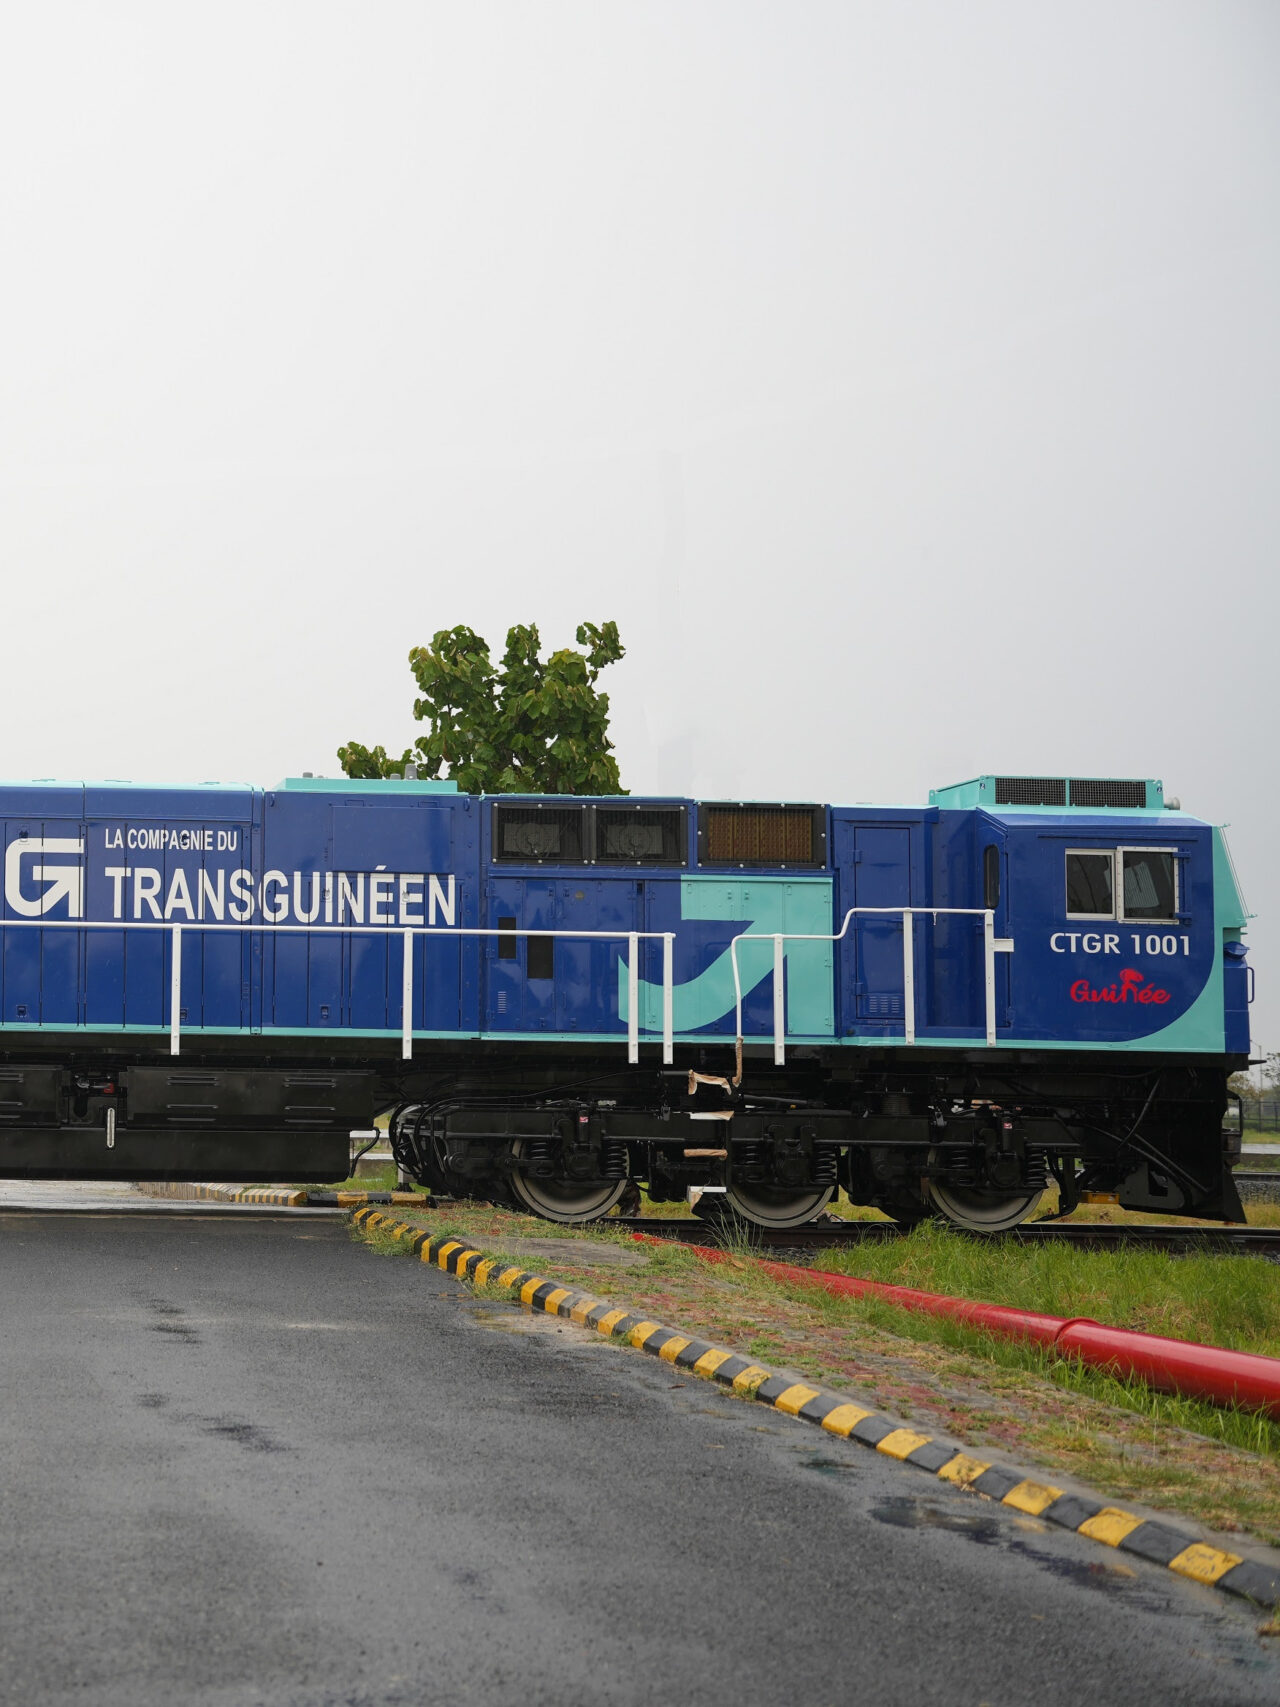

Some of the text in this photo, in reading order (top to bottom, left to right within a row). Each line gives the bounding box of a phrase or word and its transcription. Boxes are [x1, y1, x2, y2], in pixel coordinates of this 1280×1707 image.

[105, 828, 238, 851] LA COMPAGNIE DU
[105, 865, 456, 926] TRANSGUINÉEN
[1050, 933, 1190, 956] CTGR 1001
[1070, 968, 1171, 1004] Guinée
